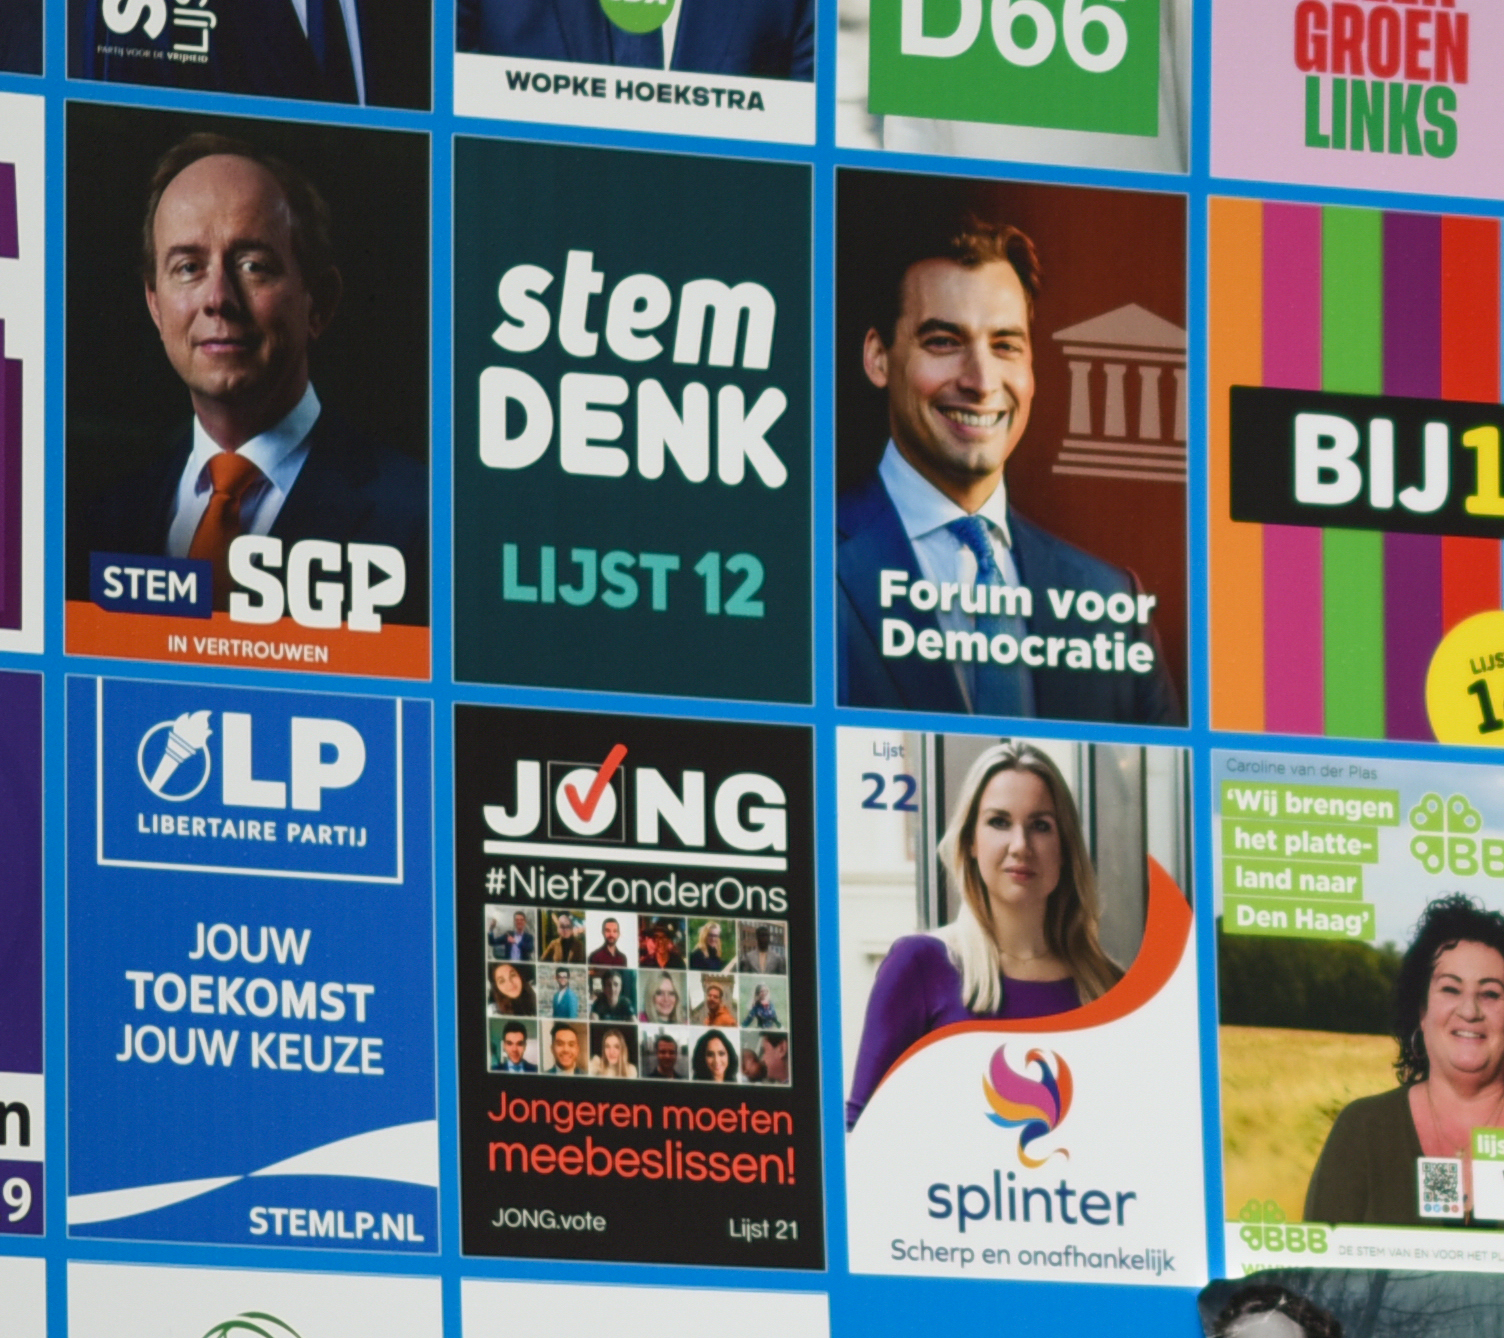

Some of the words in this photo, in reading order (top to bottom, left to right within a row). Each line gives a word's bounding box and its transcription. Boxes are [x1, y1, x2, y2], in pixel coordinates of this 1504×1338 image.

[505, 70, 607, 99] WOPKE
[615, 80, 765, 112] HOEKSTRA
[491, 249, 776, 370] stem
[478, 366, 788, 489] DENK
[102, 565, 198, 605] STEM
[227, 535, 407, 633] SGP
[879, 568, 1032, 618] Forum
[1050, 583, 1156, 624] voor
[167, 635, 187, 655] IN
[194, 636, 329, 664] VERTROUWEN
[881, 618, 1155, 674] Democratie
[221, 711, 367, 812] LP
[1226, 757, 1285, 777] Caroline
[1290, 760, 1316, 779] van
[1320, 760, 1344, 780] der
[1348, 763, 1378, 781] Plas
[138, 813, 277, 842] LIBERTAIRE
[287, 823, 367, 848] PARTIJ
[485, 863, 788, 913] #NietZonderOns
[487, 1091, 654, 1135] Jongeren
[662, 1101, 793, 1136] moeten
[487, 1137, 797, 1186] meebeslissen!
[248, 1206, 425, 1242] STEMLP.NL
[492, 1208, 607, 1233] JONG.vote
[728, 1217, 769, 1242] Lijst
[775, 1220, 798, 1240] 21
[927, 1170, 1137, 1233] splinter
[890, 1237, 974, 1267] Scherp
[983, 1243, 1011, 1265] en
[1017, 1243, 1176, 1273] onafhankelijk
[1339, 1245, 1354, 1256] DE
[1357, 1246, 1385, 1257] STEM
[1388, 1247, 1412, 1259] VAN
[1414, 1249, 1430, 1259] EN
[1432, 1249, 1465, 1260] VOOR
[1467, 1250, 1488, 1261] HET
